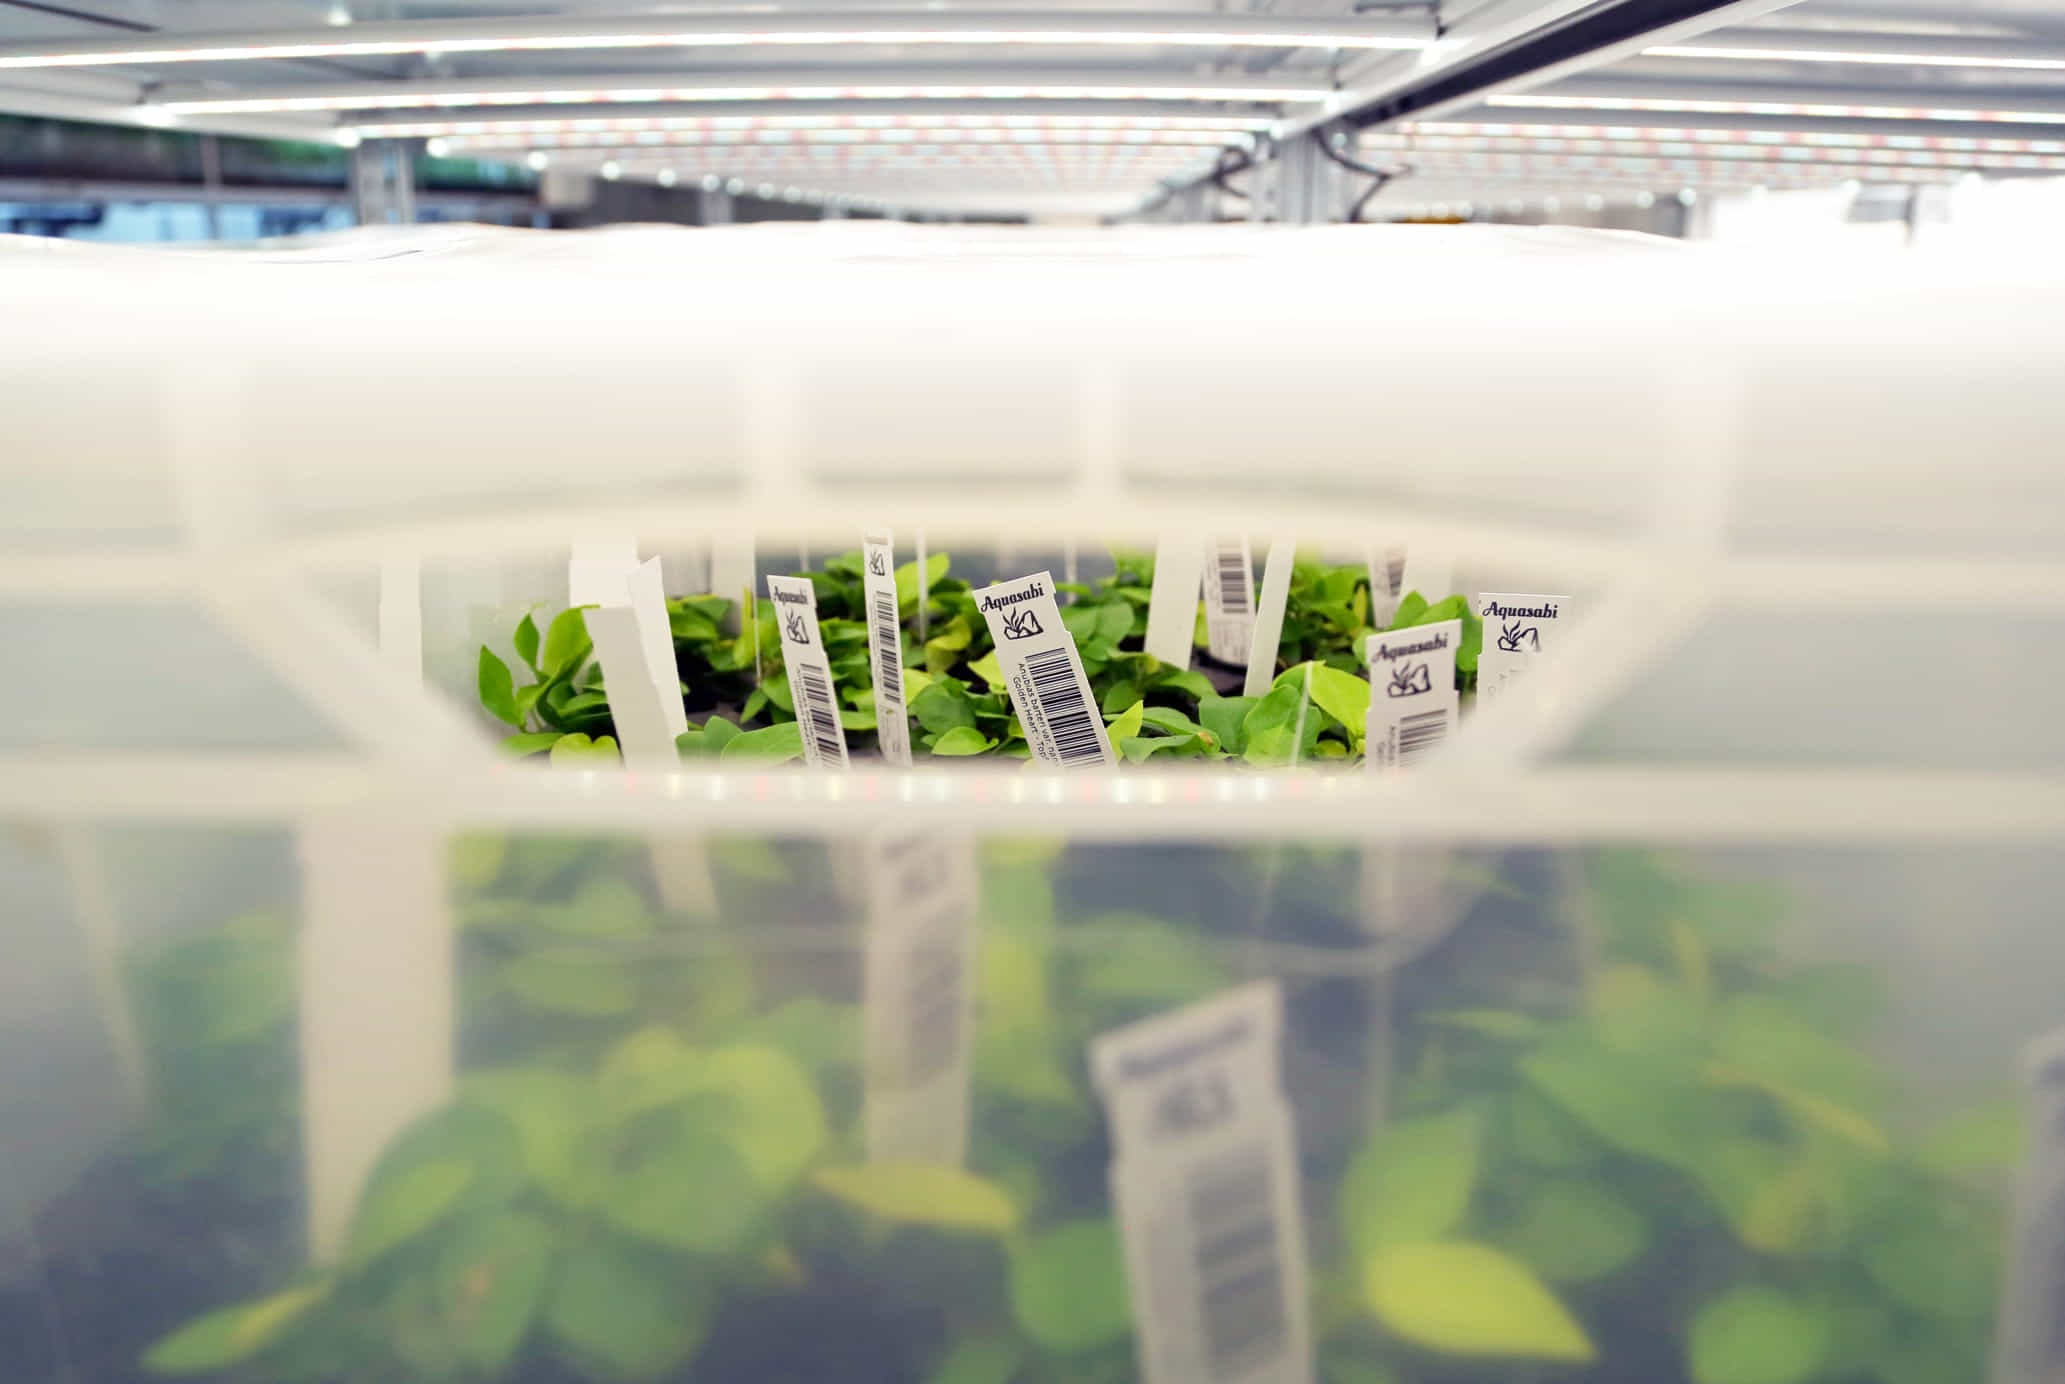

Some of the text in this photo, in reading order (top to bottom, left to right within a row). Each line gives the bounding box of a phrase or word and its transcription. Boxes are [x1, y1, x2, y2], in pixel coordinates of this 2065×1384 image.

[981, 583, 1044, 612] Aquasabi
[1482, 601, 1558, 620] Aquasabi
[1371, 632, 1448, 662] Aquasabi
[1018, 663, 1035, 697] Anubias
